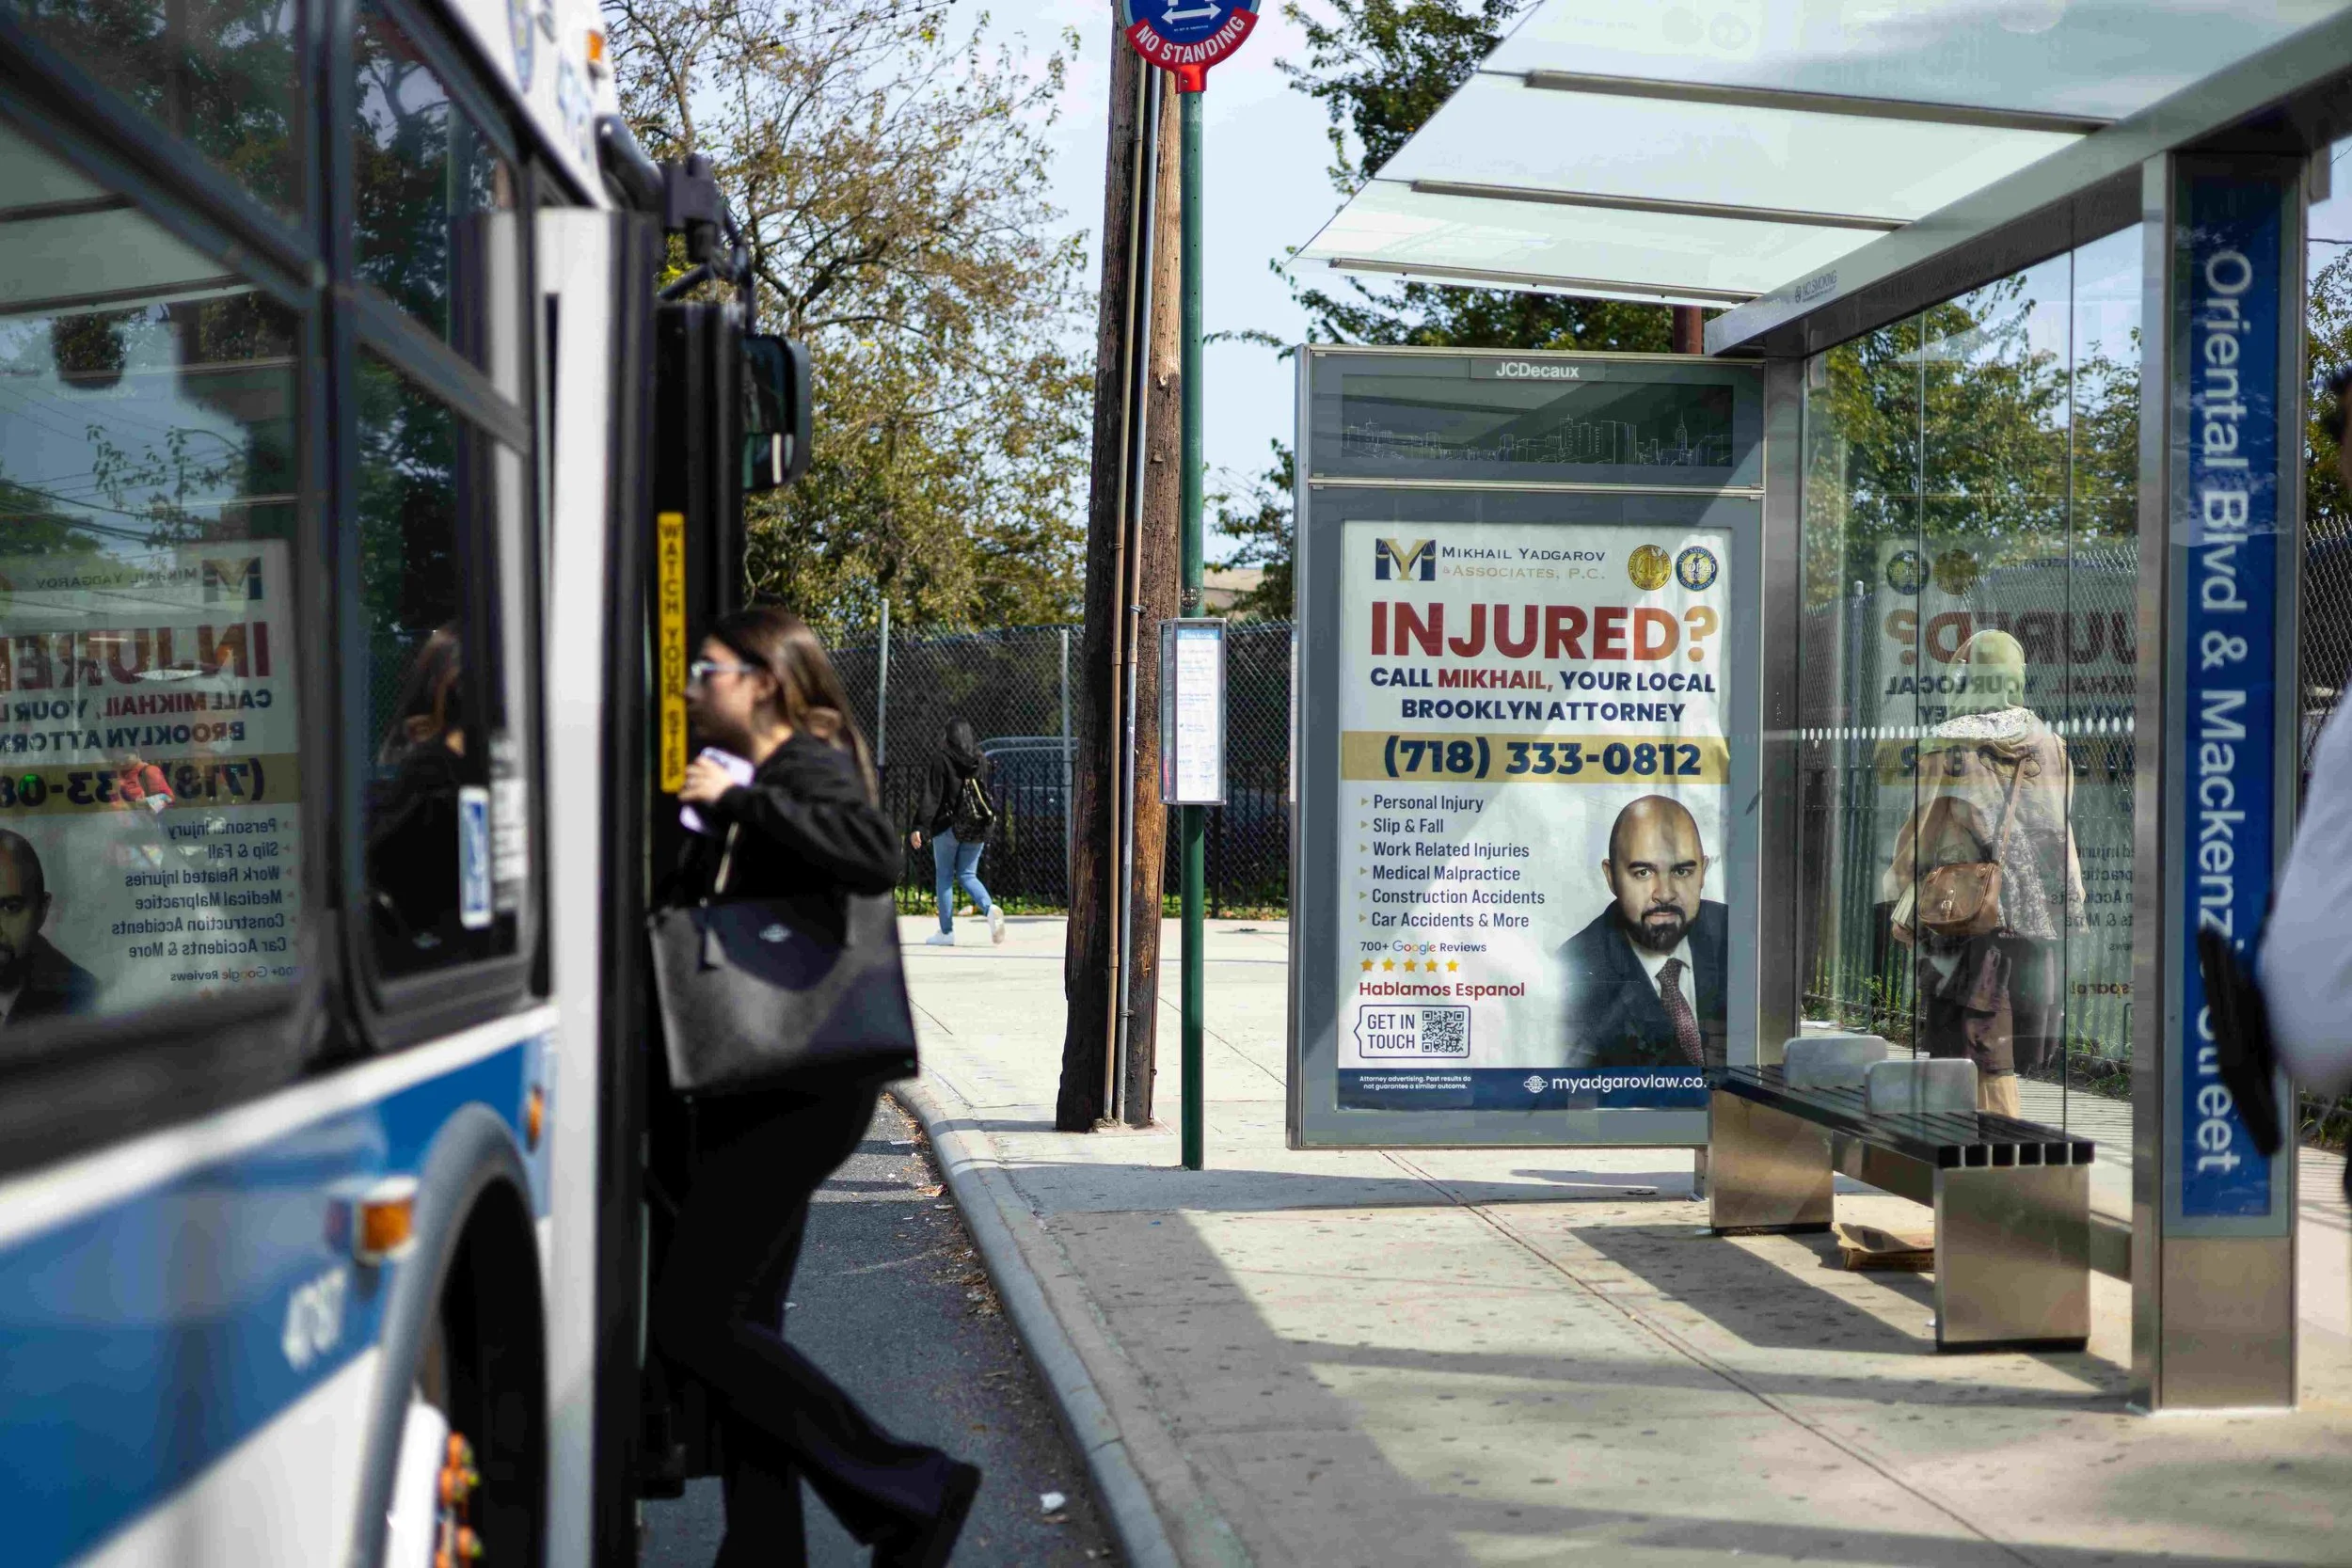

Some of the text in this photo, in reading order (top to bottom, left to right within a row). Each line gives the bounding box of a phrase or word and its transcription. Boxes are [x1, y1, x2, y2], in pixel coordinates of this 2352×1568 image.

[1136, 16, 1246, 63] NO STANDING
[2203, 249, 2253, 467] Oriental
[1496, 361, 1581, 378] JCDecaux
[1442, 546, 1606, 562] MIKHAIL YADGAROV
[2201, 489, 2249, 611] Blvd
[1452, 564, 1560, 580] ASSOCIATES,
[1568, 567, 1606, 579] P.C.
[1371, 601, 1719, 662] INJURED?
[663, 523, 682, 782] WATCH YOUR STEP
[2201, 629, 2249, 671] &
[1370, 667, 1716, 693] CALL MIKHAIL, YOUR LOCAL
[1402, 699, 1686, 722] BROOKLYN ATTORNEY
[1384, 735, 1701, 778] (718) 333-0812
[1373, 795, 1485, 814] Personal Injury
[1373, 818, 1444, 835] Slip & Fall
[2197, 689, 2248, 979] Mackenz
[1373, 841, 1531, 860] Work Related Injuries
[1373, 864, 1521, 882] Medical Malpractice
[1372, 888, 1546, 904] Construction Accidents
[1372, 911, 1530, 927] Car Accidents & More
[1360, 940, 1487, 956] 700+ Google Reviews
[1359, 982, 1525, 1000] Hablamos Espanol
[1367, 1014, 1415, 1030] GET IN
[1367, 1034, 1416, 1050] TOUCH
[1388, 1075, 1425, 1084] advertising.
